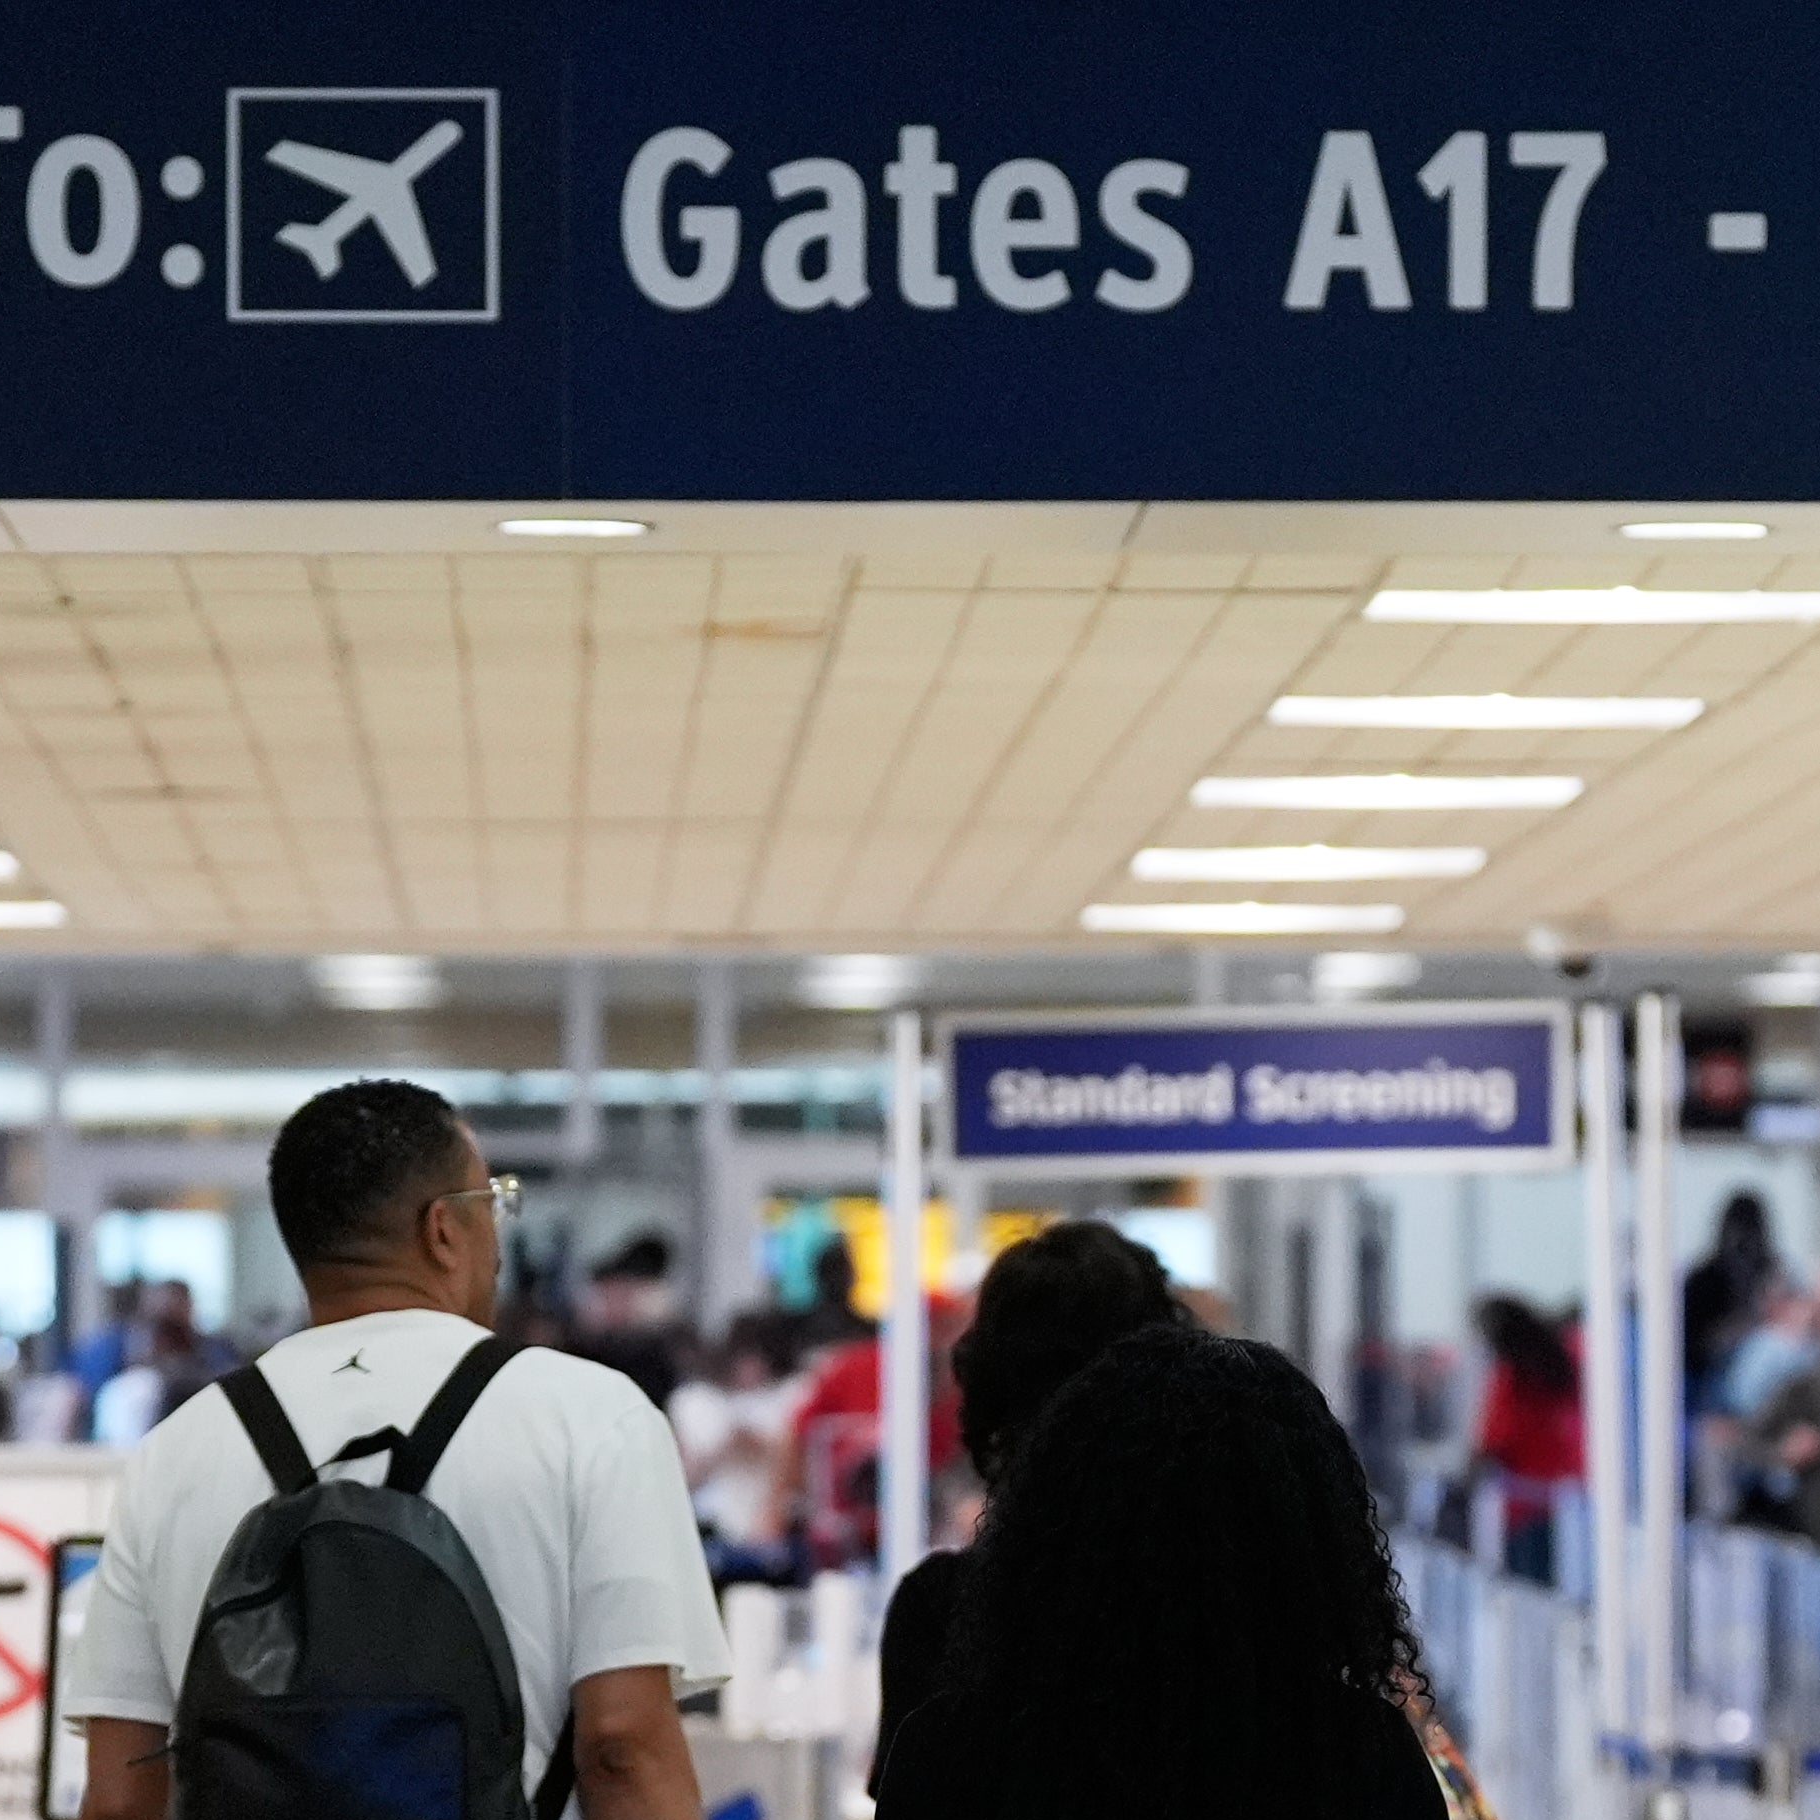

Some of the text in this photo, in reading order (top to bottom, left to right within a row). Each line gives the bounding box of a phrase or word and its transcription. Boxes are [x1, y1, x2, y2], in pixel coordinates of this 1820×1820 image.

[620, 125, 1194, 313] Gates
[1283, 129, 1608, 313] A17
[1707, 211, 1769, 252] -
[987, 1057, 1518, 1134] Standard Screening
